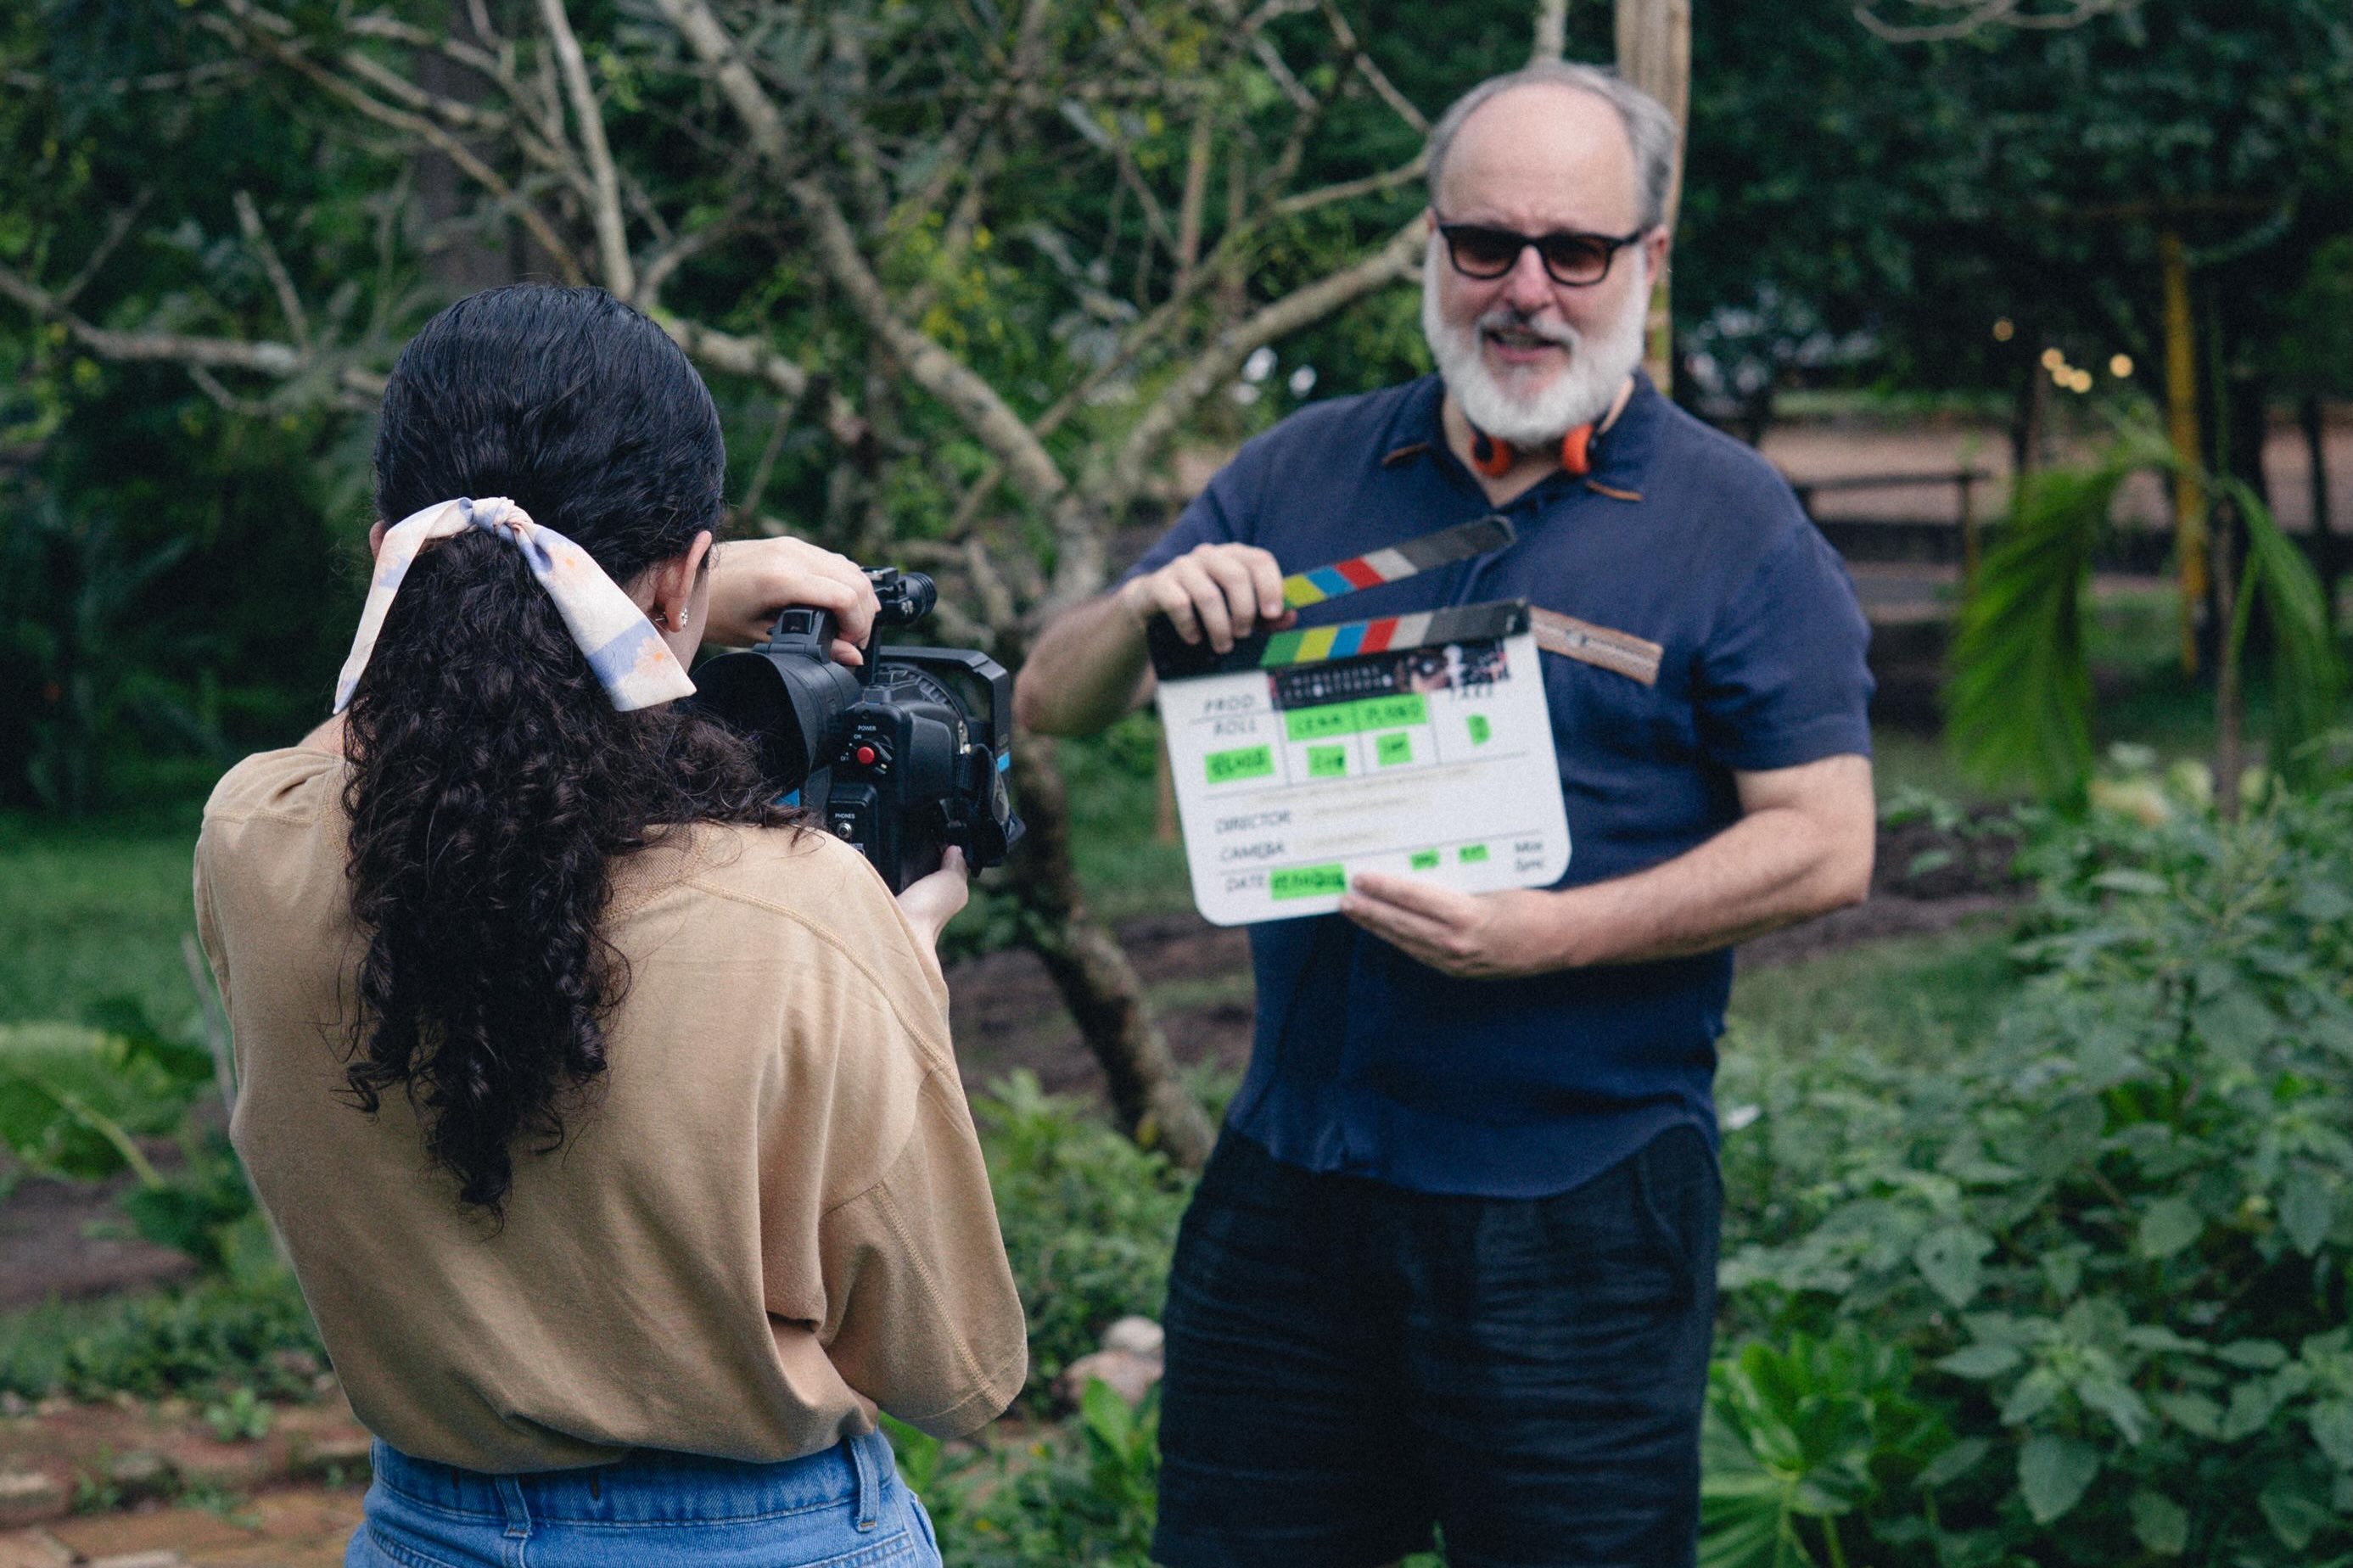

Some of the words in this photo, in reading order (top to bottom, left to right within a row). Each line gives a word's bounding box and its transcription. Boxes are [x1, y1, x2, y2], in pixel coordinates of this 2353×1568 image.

[1213, 719, 1256, 736] ROLL
[1215, 809, 1291, 835] DIRECTOR
[1220, 840, 1285, 862] CAMERA
